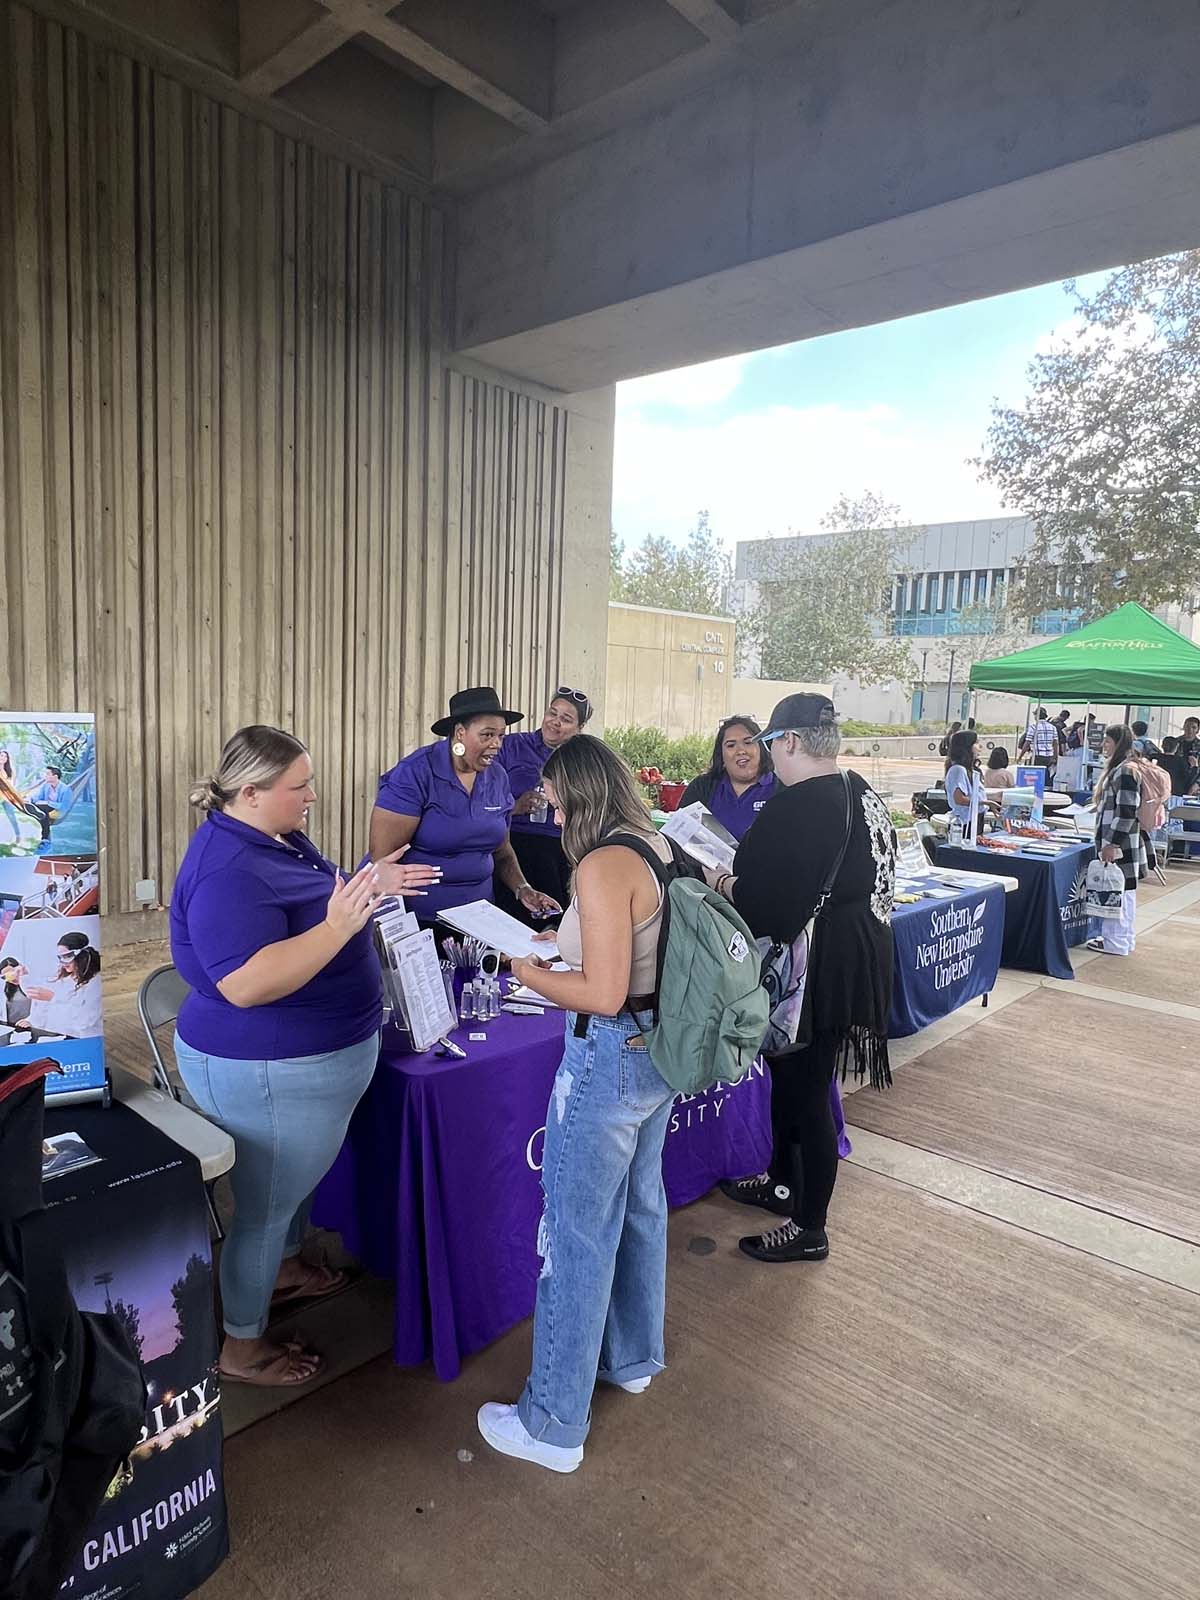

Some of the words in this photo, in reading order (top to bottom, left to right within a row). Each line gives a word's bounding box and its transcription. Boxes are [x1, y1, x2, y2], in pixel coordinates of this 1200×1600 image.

[705, 631, 725, 644] CNTL
[713, 660, 724, 673] 10
[930, 903, 971, 938] Southern
[915, 943, 939, 970] New
[938, 915, 984, 961] Hampshire
[670, 1098, 724, 1133] SITY
[83, 1468, 217, 1571] CALIFORNIA
